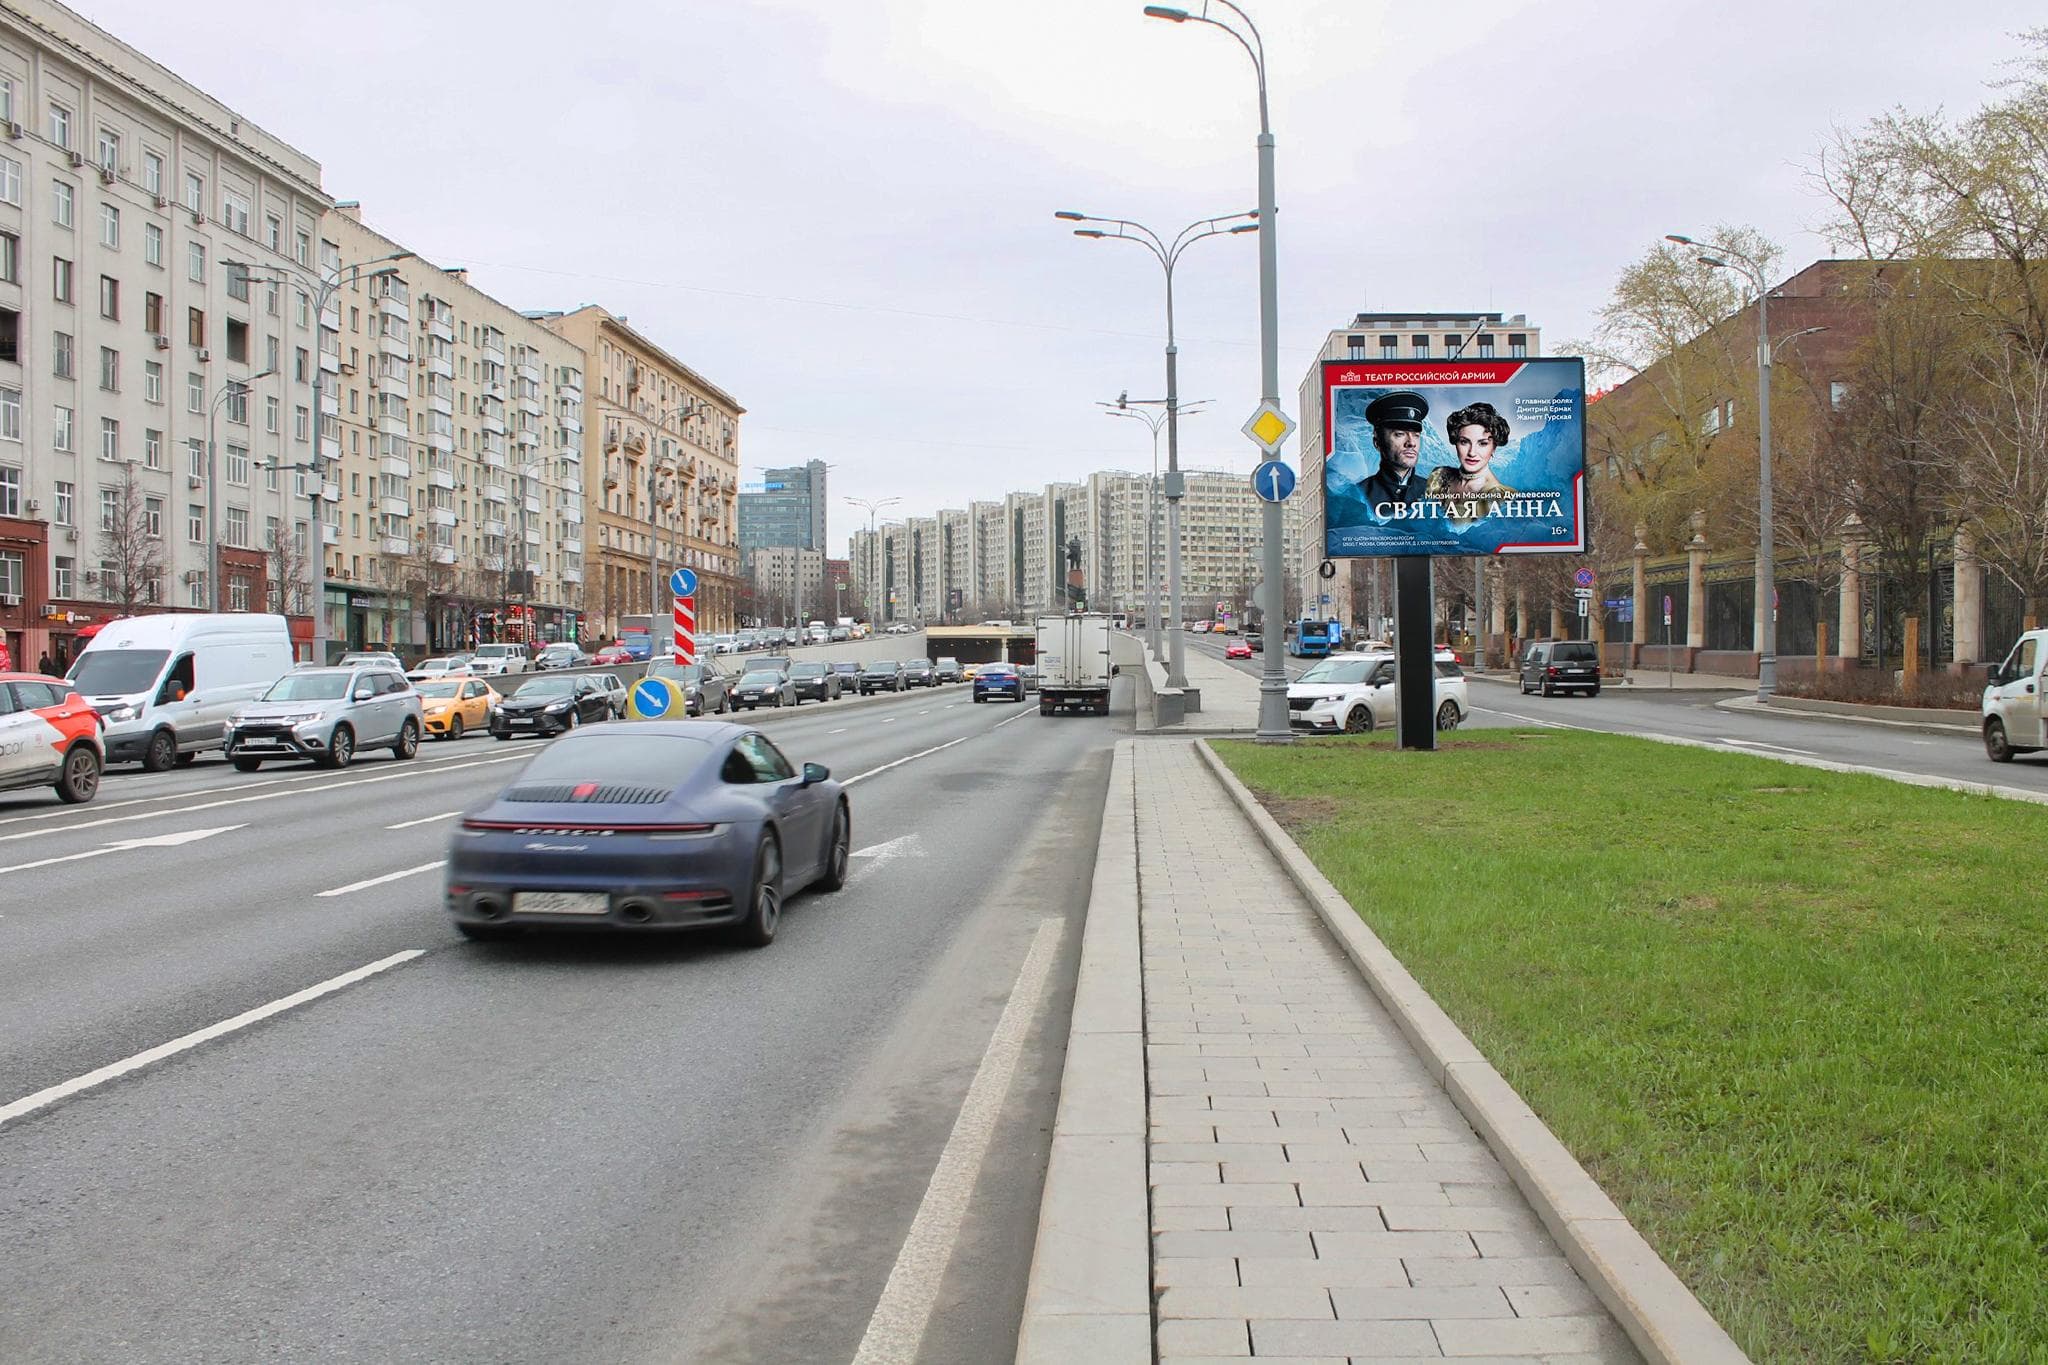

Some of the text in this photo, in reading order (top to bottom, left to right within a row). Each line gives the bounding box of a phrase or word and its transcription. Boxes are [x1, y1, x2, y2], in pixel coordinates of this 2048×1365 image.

[1365, 371, 1496, 381] ТЕАТР РОССИЙСКОЙ АРМИИ
[1424, 490, 1561, 500] Мюзикл Максима Дунаевского
[1375, 499, 1564, 520] СВЯТАЯ АННА
[1551, 526, 1568, 535] 16+
